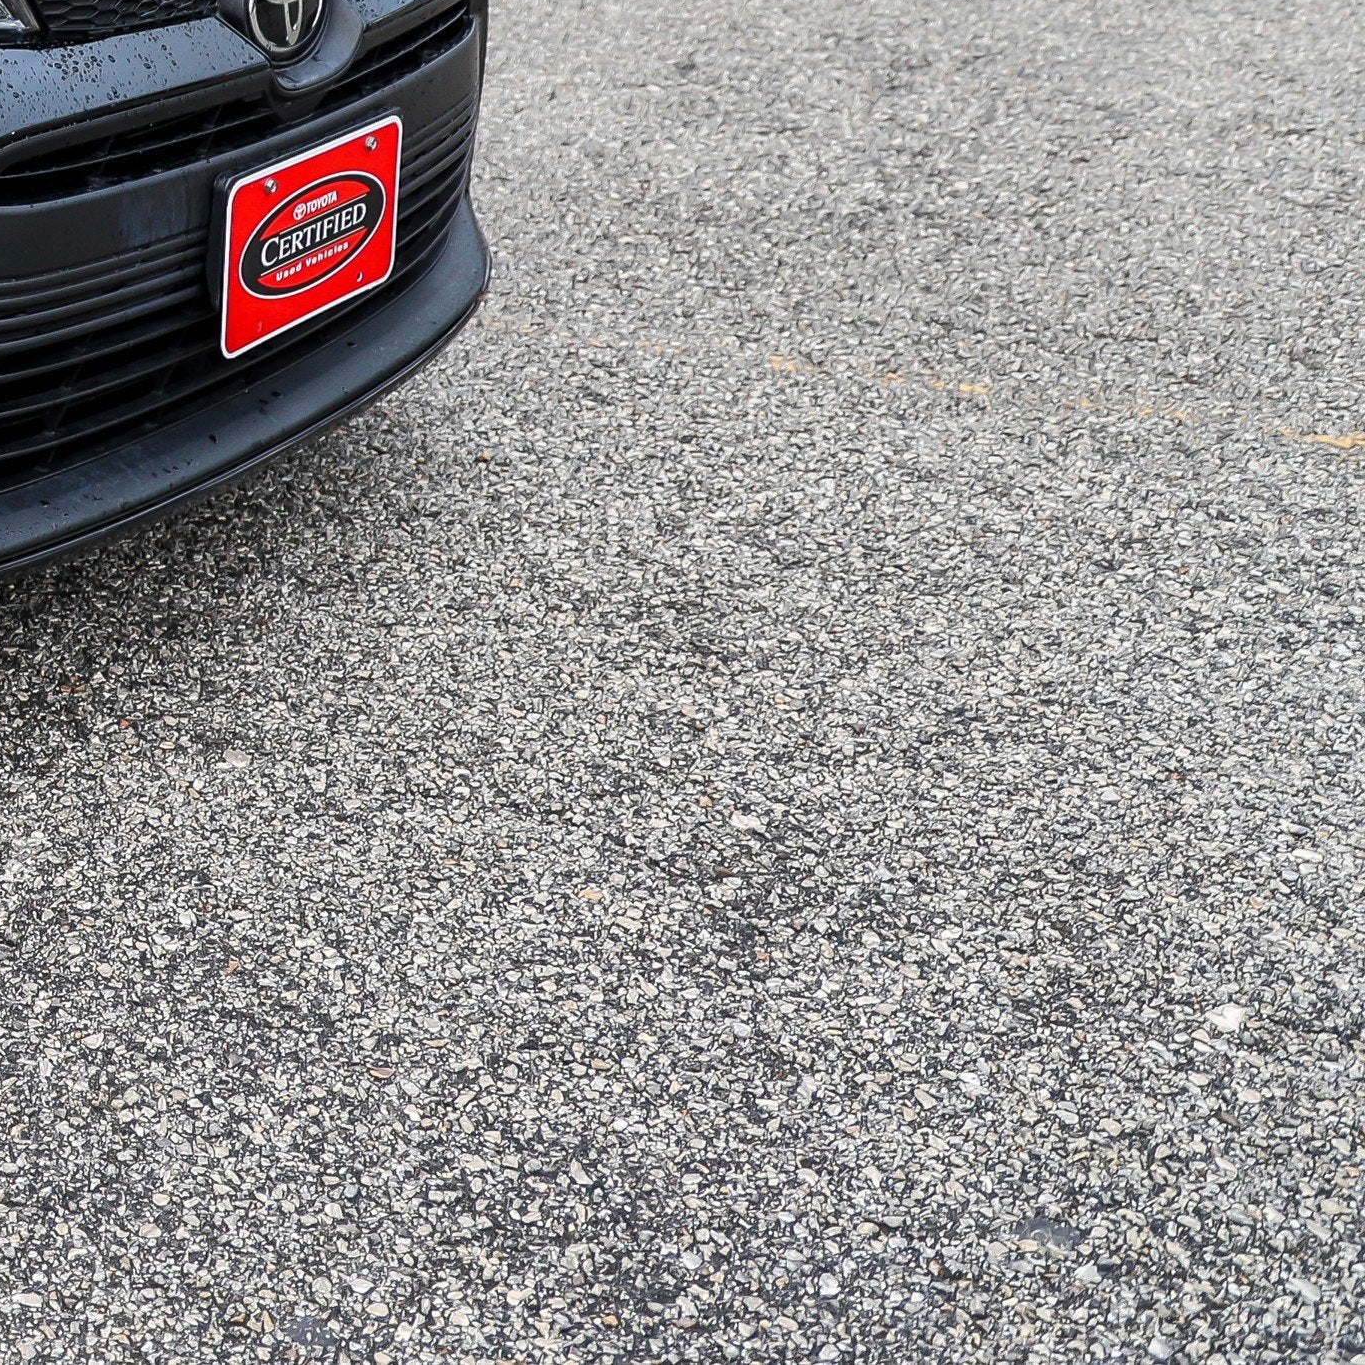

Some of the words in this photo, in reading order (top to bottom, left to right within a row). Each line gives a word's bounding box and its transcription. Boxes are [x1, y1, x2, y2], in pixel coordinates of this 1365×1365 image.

[306, 190, 338, 215] TOYOTA
[261, 203, 367, 267] CERTIFIED
[275, 262, 303, 282] Used
[305, 241, 349, 267] Vehicles
